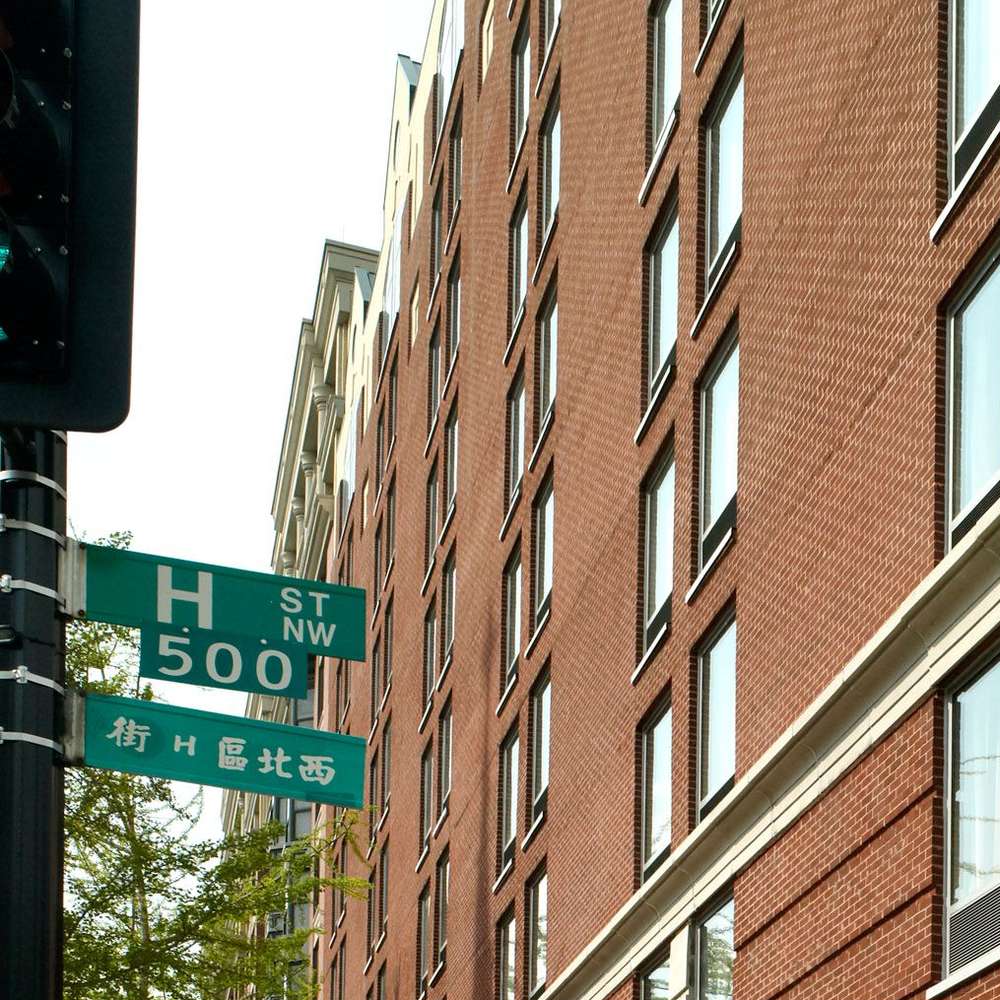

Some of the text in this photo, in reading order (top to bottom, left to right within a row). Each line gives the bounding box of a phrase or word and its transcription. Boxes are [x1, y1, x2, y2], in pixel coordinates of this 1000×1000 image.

[157, 565, 330, 629] H ST
[283, 617, 336, 647] NW
[158, 634, 293, 691] 500
